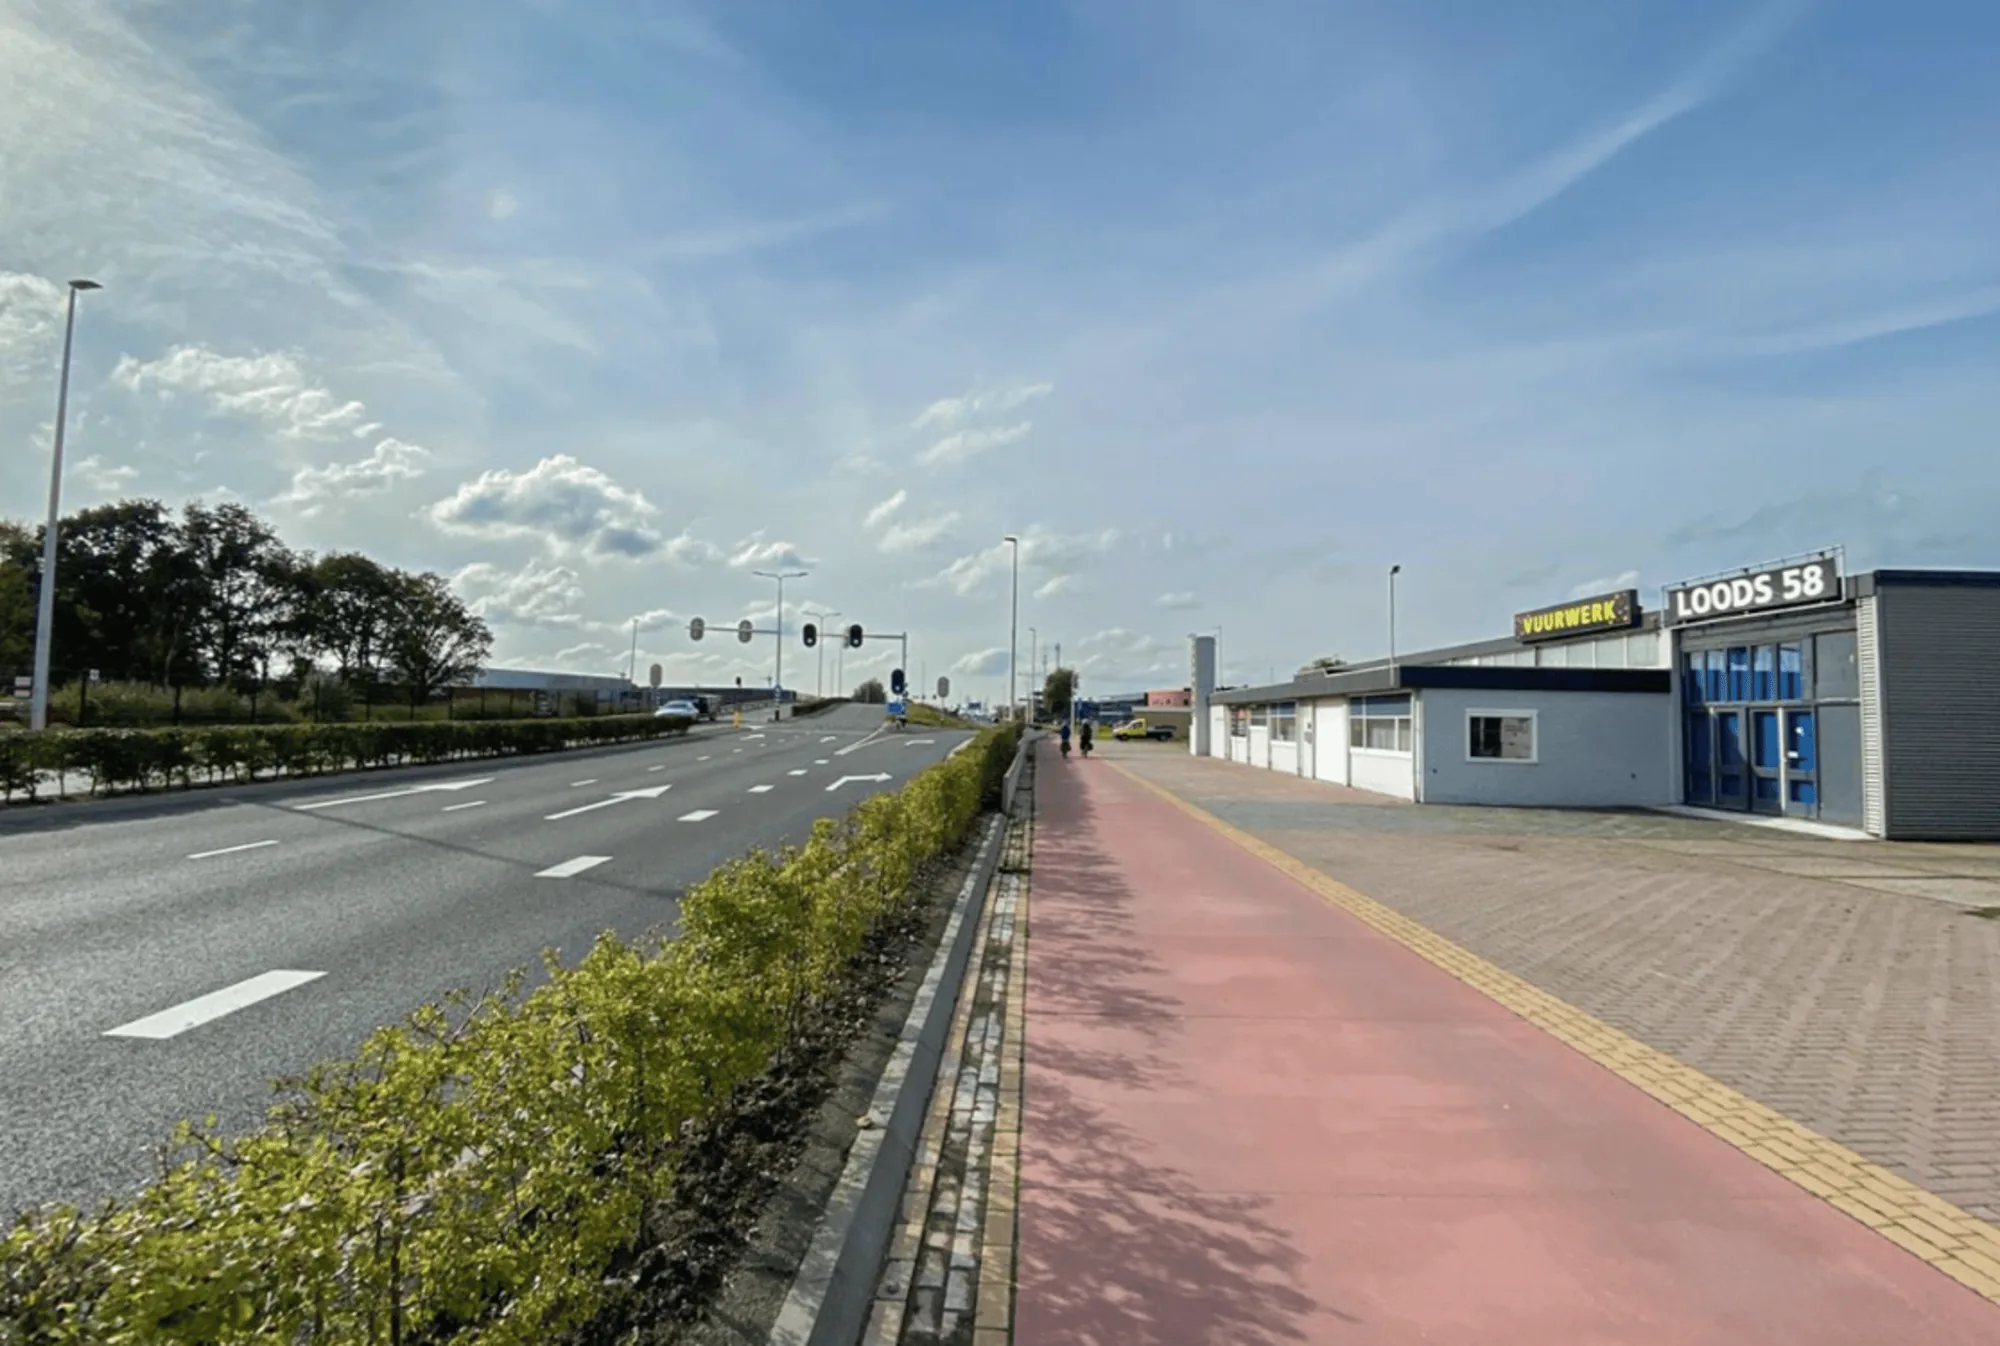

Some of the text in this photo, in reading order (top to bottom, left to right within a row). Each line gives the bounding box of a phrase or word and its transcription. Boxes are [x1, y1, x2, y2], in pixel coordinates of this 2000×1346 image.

[1677, 564, 1824, 617] LOODS 58
[1523, 600, 1616, 634] VUURWERK
